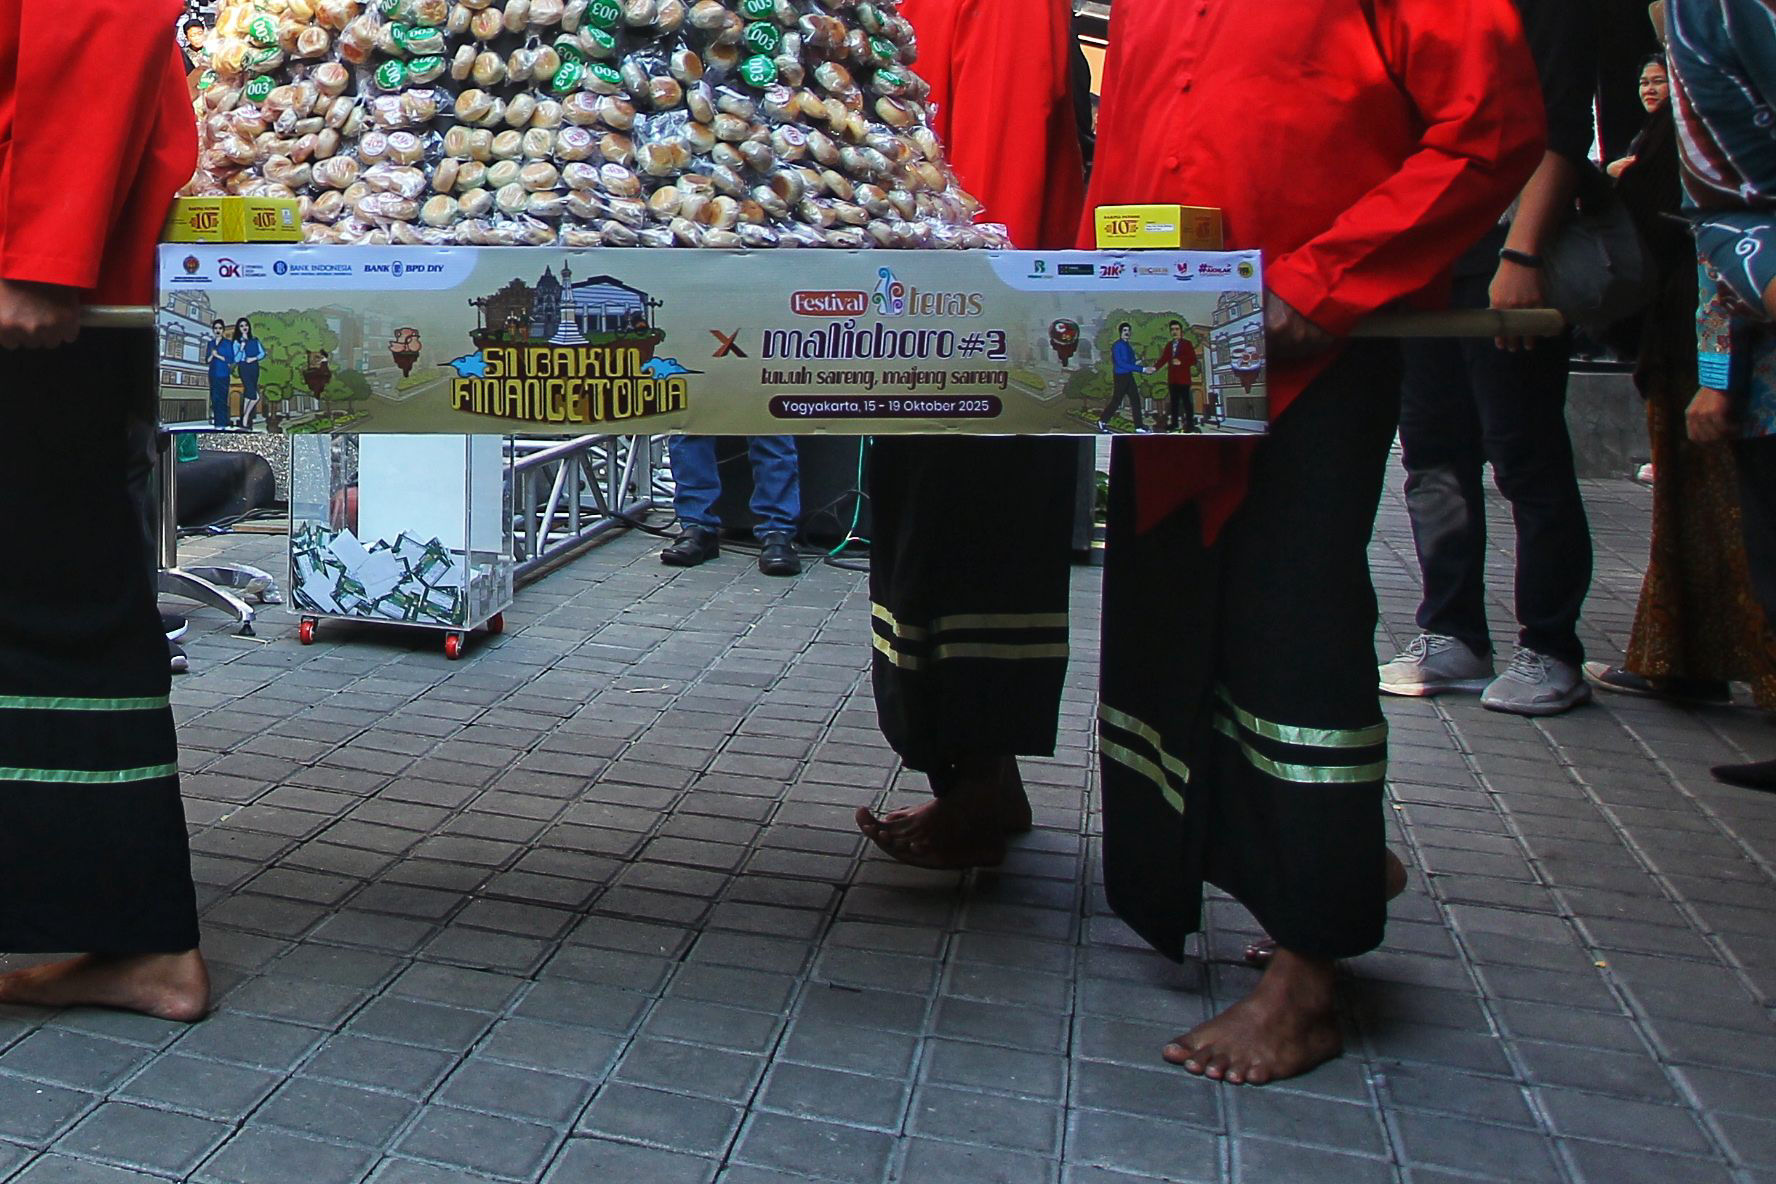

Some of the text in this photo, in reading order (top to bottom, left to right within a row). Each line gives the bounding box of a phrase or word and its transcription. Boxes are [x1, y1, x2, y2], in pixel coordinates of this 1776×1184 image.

[592, 3, 619, 21] 003
[751, 28, 774, 50] 003
[385, 60, 400, 82] 003
[556, 62, 574, 86] 003
[595, 66, 620, 79] 003
[749, 58, 763, 82] 003
[248, 83, 268, 95] 003
[1111, 219, 1130, 235] 10
[290, 264, 353, 272] BANK INDONESIA
[364, 264, 445, 273] BANK BPD DIY
[794, 286, 984, 316] Festival teras
[761, 318, 955, 359] malioboro
[815, 370, 878, 391] sareng,
[881, 366, 947, 391] majeng
[951, 370, 1009, 390] sareng
[450, 377, 689, 422] FINANCETOPIA
[782, 400, 862, 415] Yogyakarta,
[864, 400, 876, 412] 15
[888, 400, 901, 412] 19
[903, 399, 956, 412] Oktober
[958, 400, 990, 412] 2025
